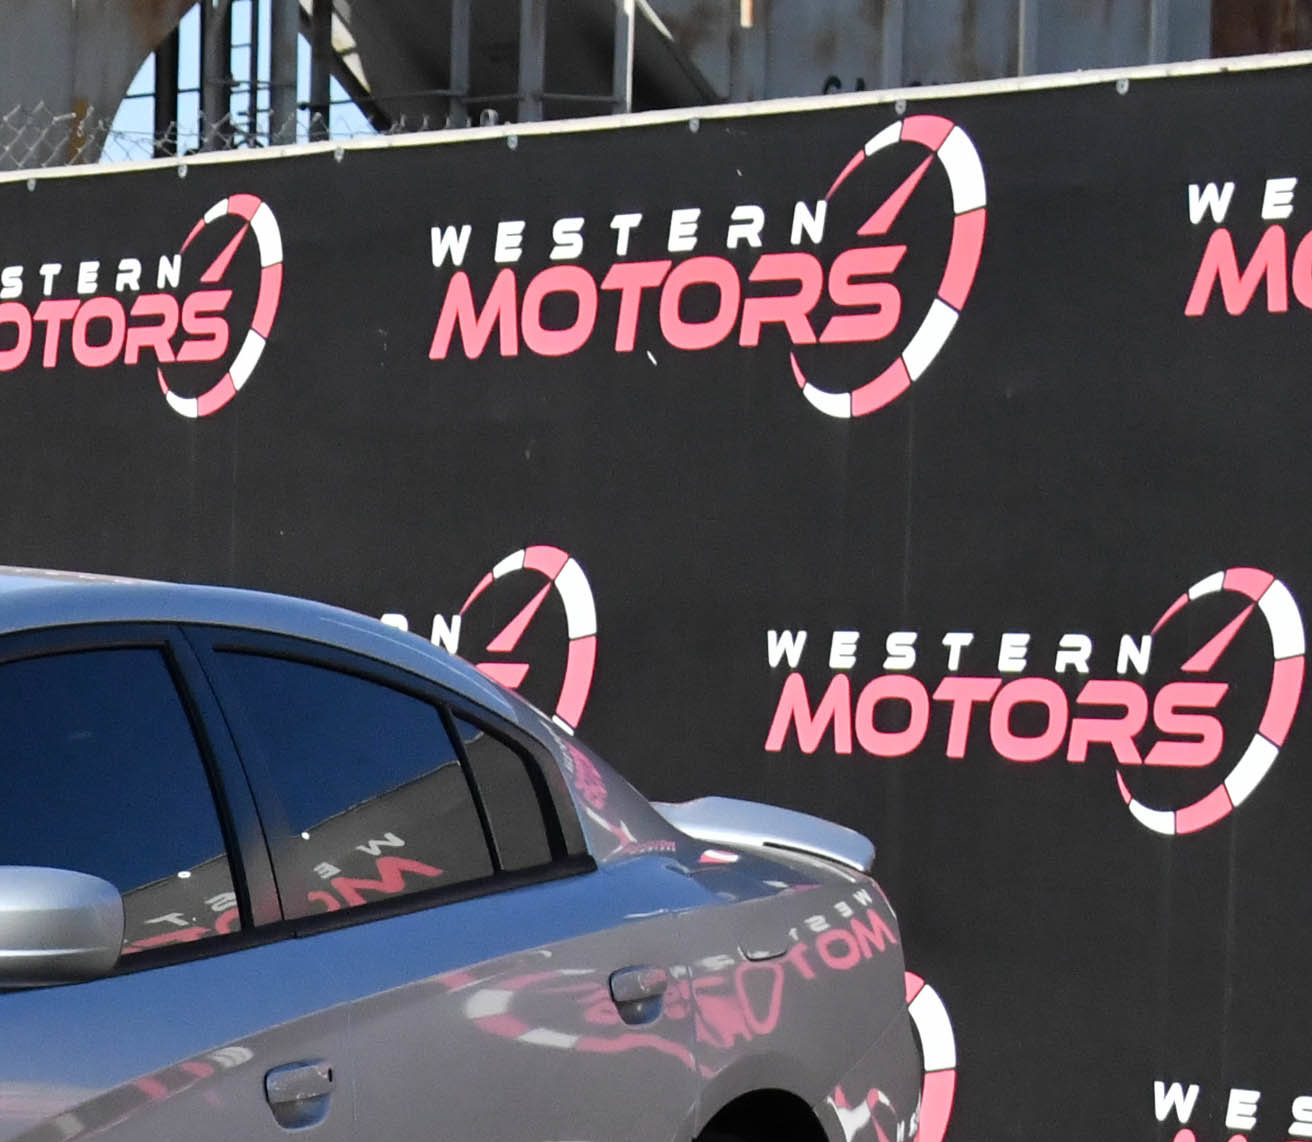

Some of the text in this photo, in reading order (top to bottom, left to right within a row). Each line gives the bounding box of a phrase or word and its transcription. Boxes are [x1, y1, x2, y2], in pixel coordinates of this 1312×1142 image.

[430, 200, 827, 267] WESTERN
[1184, 224, 1312, 316] M
[428, 245, 907, 360] MOTORS
[767, 630, 1153, 674] WESTERN
[764, 671, 1229, 766] MOTORS
